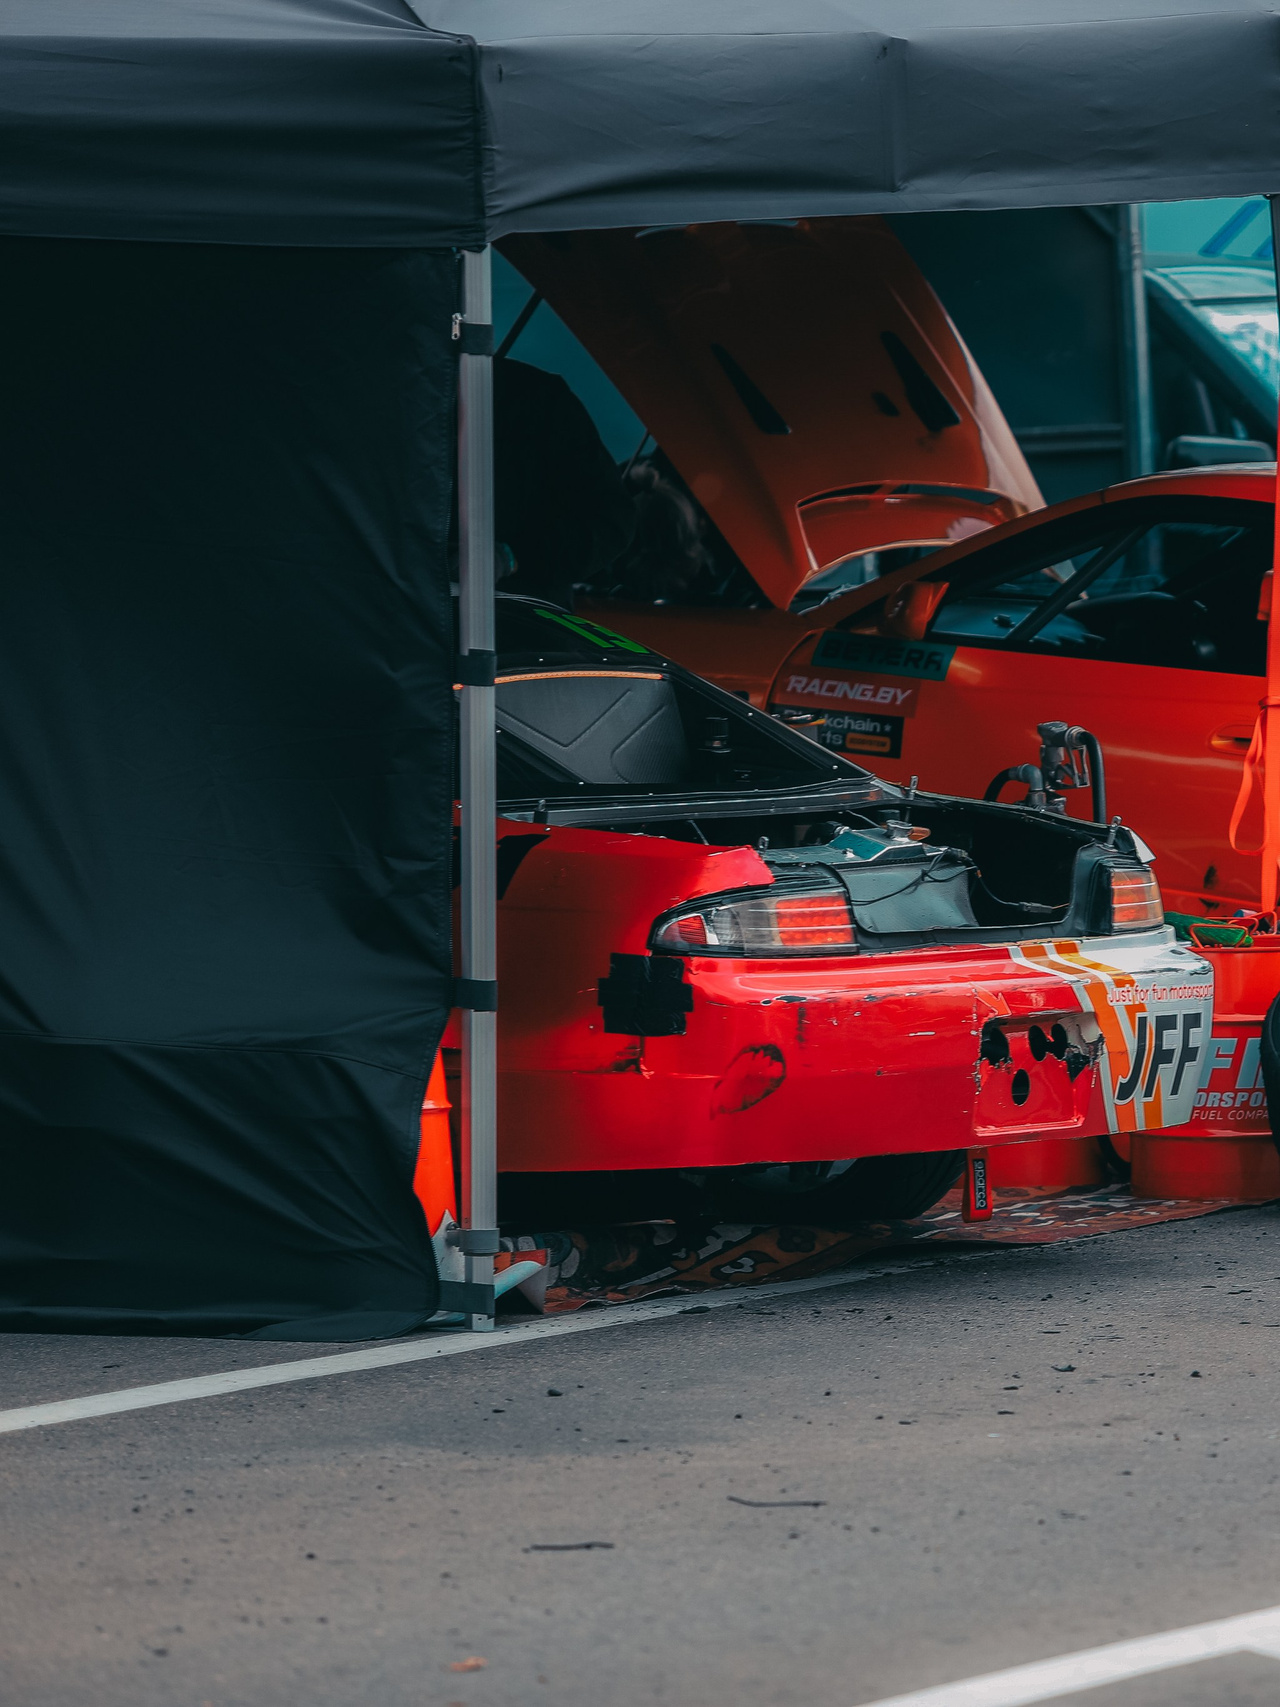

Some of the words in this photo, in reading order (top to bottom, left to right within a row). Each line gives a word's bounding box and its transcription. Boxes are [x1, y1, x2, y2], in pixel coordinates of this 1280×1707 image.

[820, 638, 946, 672] BETERA
[786, 674, 913, 705] RACING.BY
[1108, 985, 1132, 1003] Just
[1134, 984, 1149, 1003] for
[1152, 983, 1167, 1001] fun
[1115, 1012, 1203, 1102] JFF
[1192, 1109, 1224, 1120] FUEL
[973, 1160, 987, 1209] sparco
